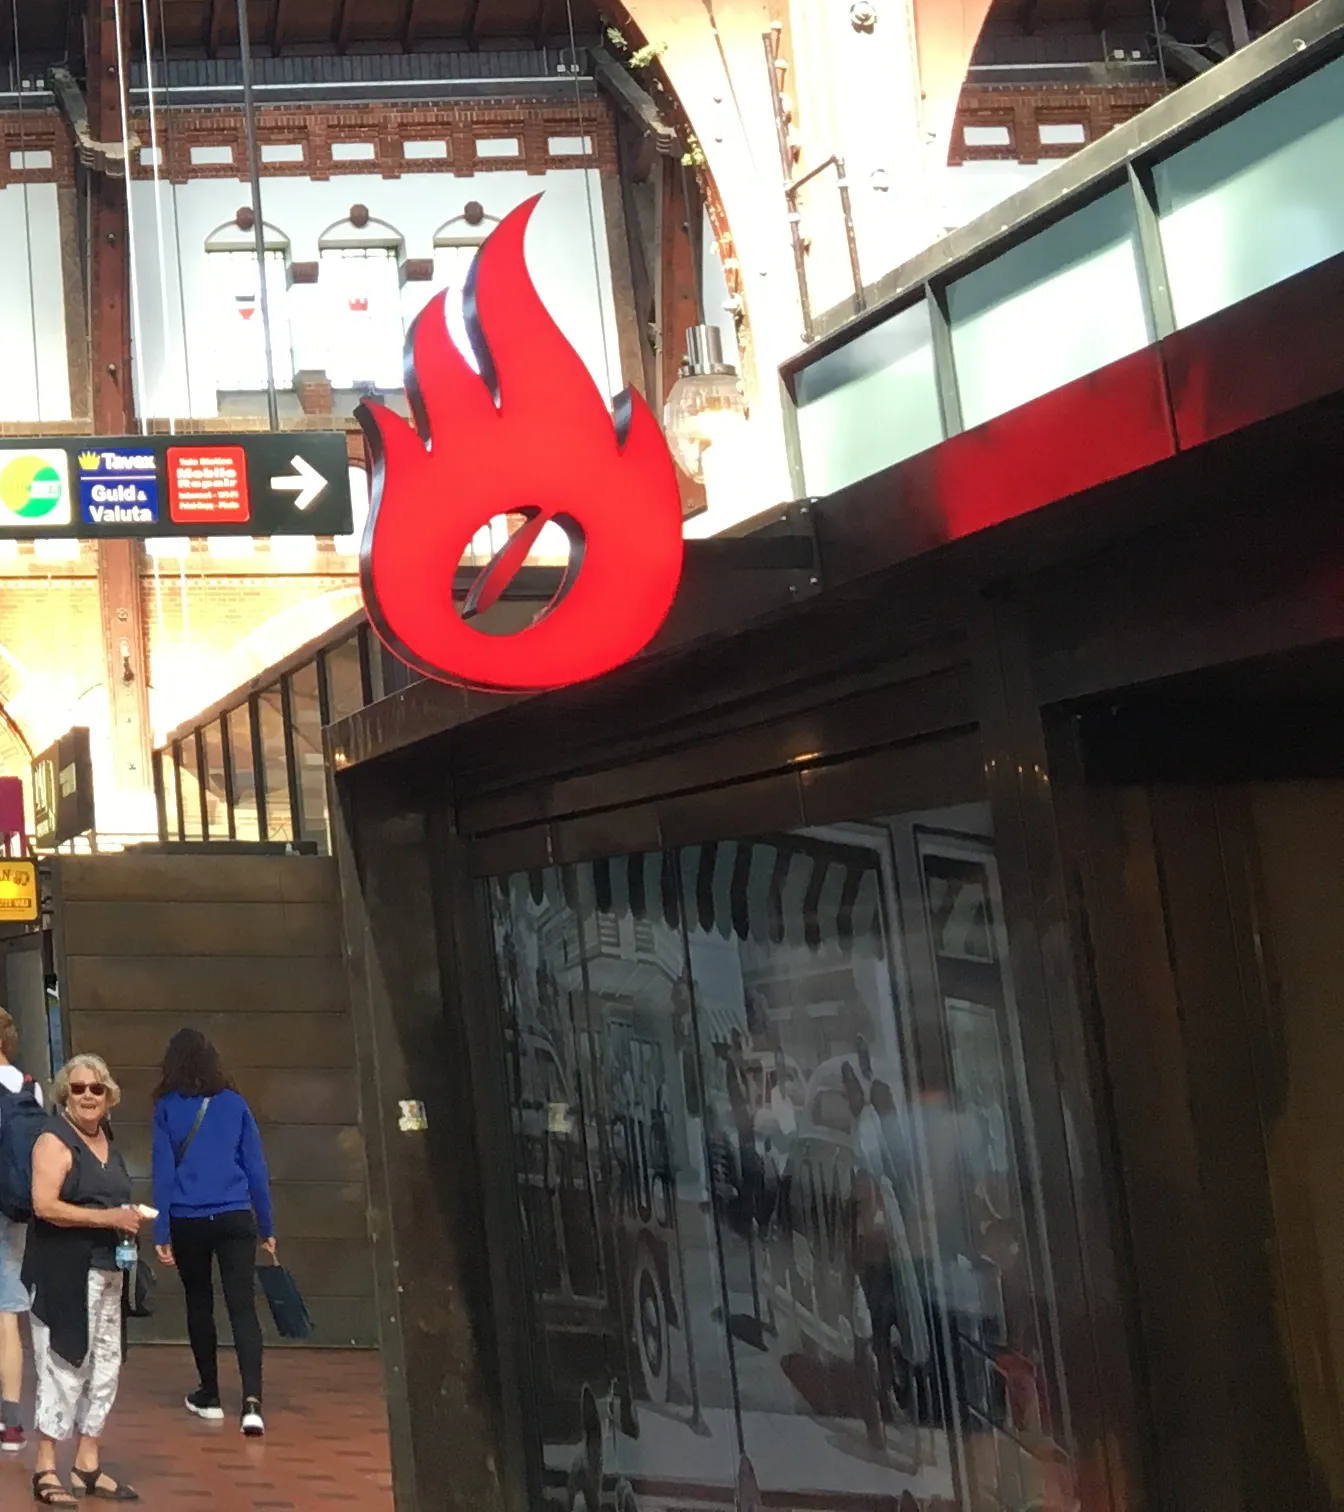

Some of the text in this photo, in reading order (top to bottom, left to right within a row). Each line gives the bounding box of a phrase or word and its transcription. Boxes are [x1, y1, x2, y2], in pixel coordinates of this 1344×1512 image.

[176, 467, 237, 479] Mobile
[177, 478, 238, 490] Repair
[91, 484, 148, 502] Guld &
[89, 505, 153, 522] Valuta
